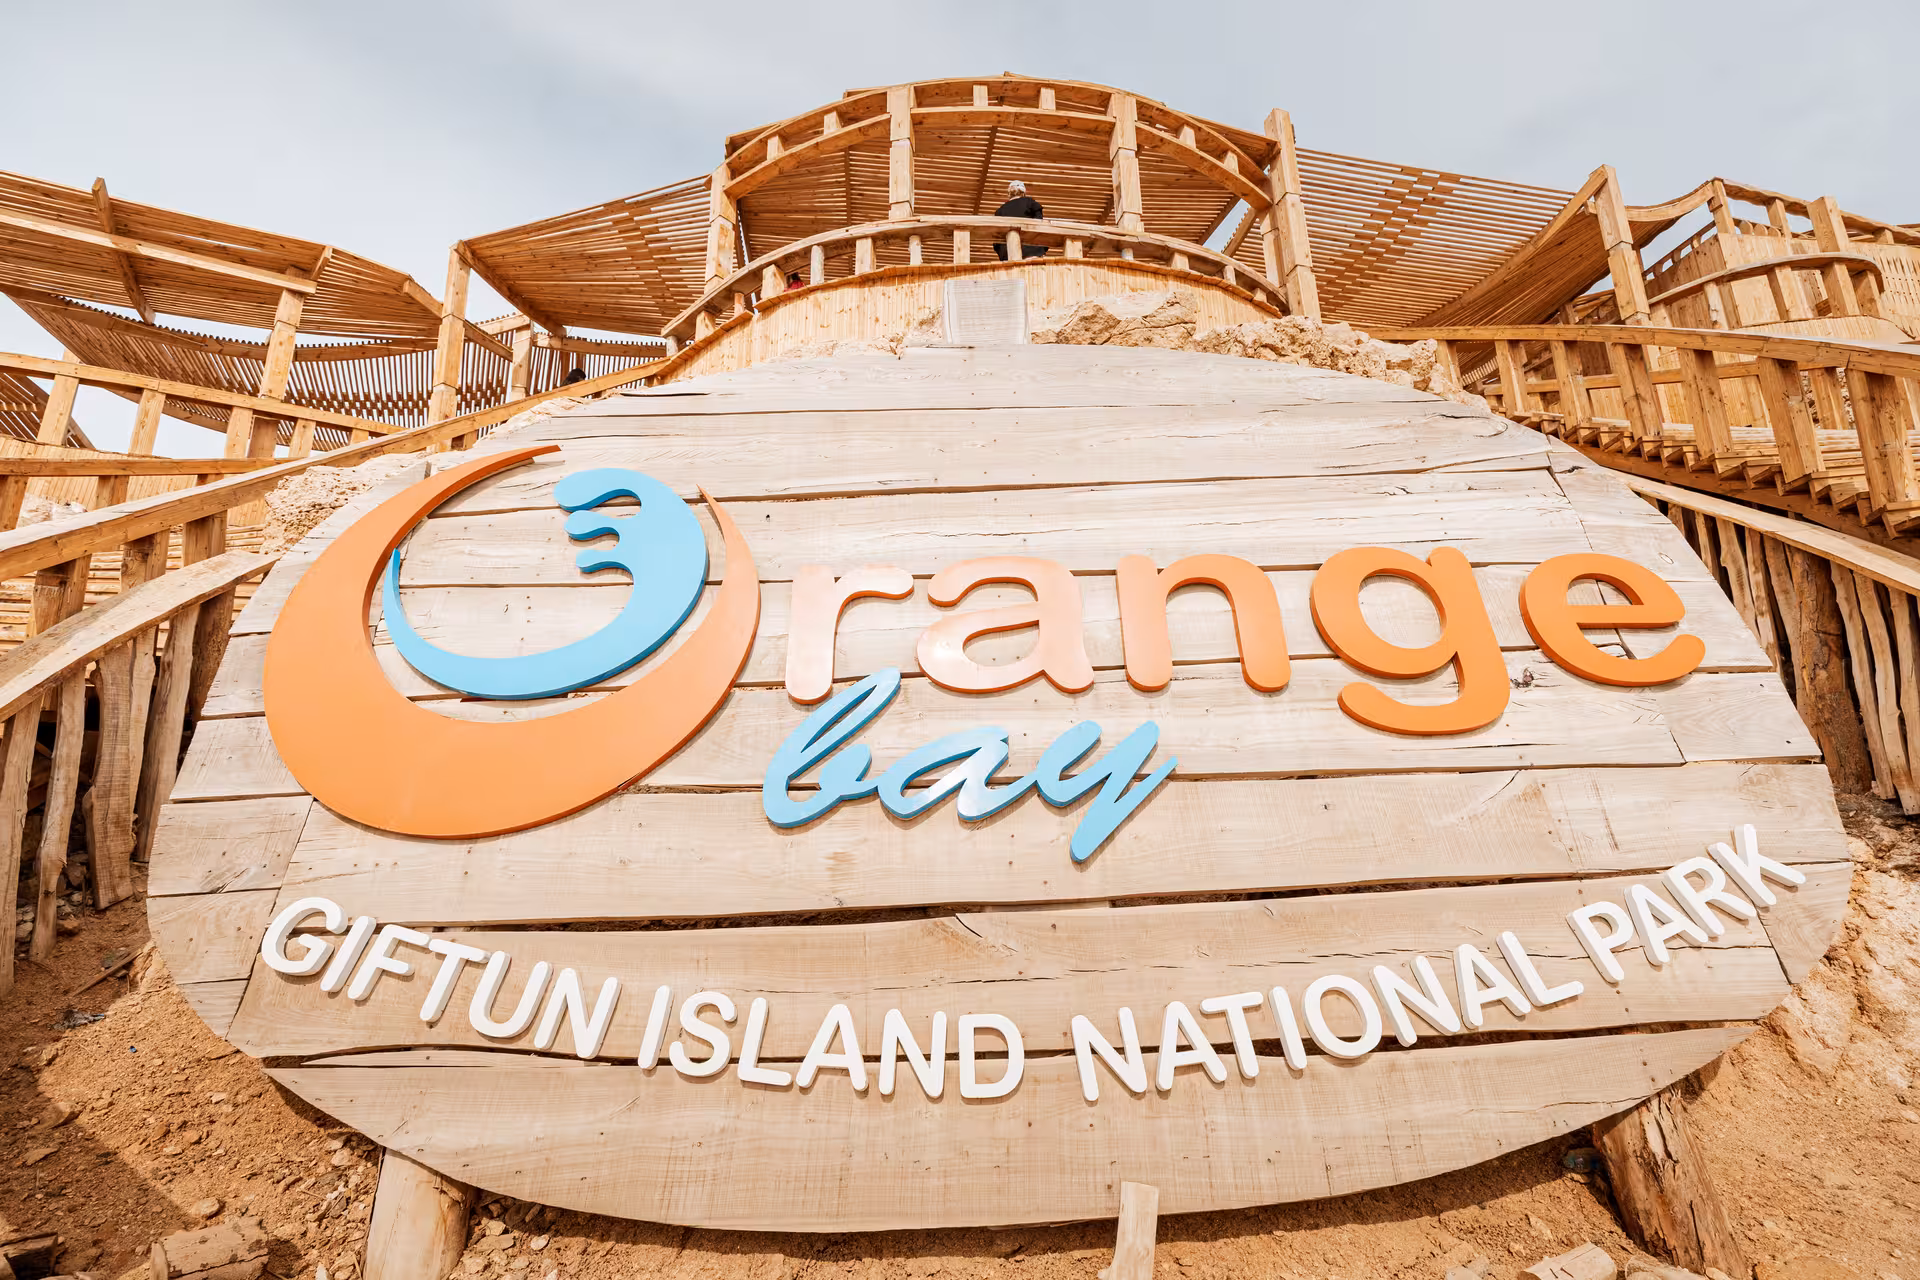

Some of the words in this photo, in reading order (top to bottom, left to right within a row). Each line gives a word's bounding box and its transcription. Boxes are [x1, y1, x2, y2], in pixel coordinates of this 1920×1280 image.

[763, 667, 1177, 863] bay
[261, 897, 622, 1060] GIFTUN
[638, 984, 1025, 1100] ISLAND
[1071, 931, 1584, 1102] NATIONAL
[1567, 824, 1807, 984] PARK
